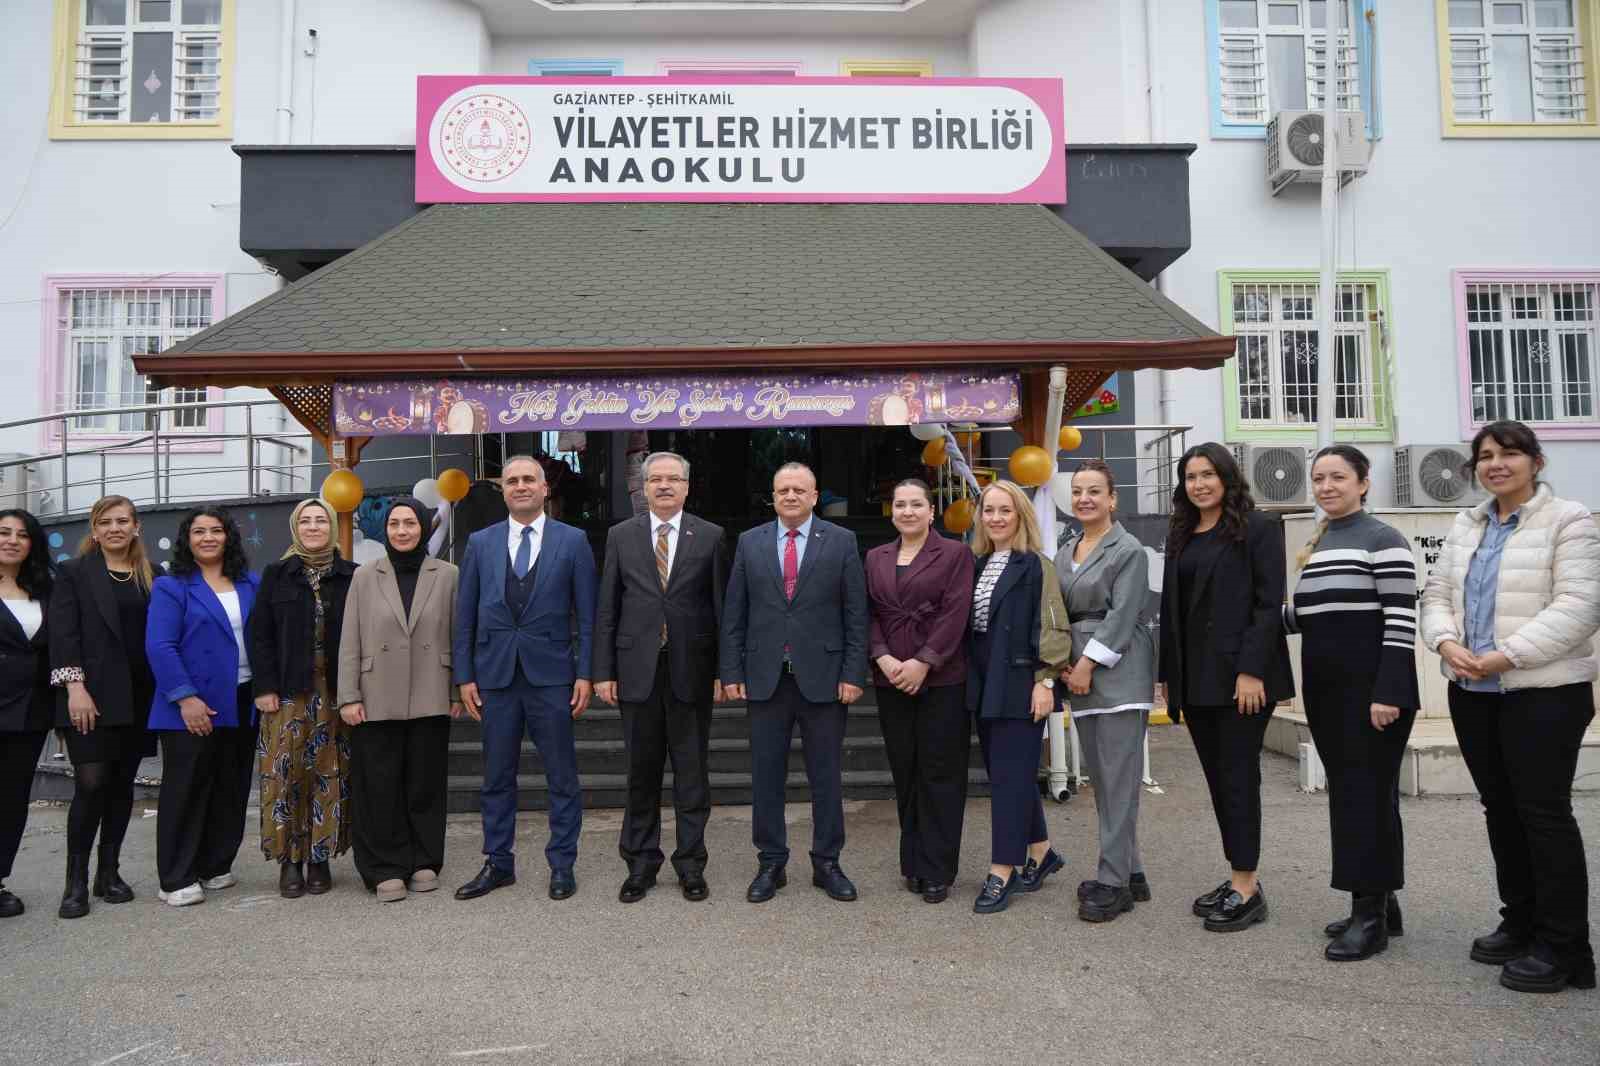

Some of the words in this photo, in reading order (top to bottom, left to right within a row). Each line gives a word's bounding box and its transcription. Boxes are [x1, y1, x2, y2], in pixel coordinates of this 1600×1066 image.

[553, 91, 635, 105] GAZİANTEP
[647, 91, 735, 108] ŞEHİTKAMİL
[553, 107, 760, 149] VİLAYETLER
[773, 107, 901, 150] HİZMET
[912, 108, 1033, 151] BİRLİĞİ
[548, 157, 805, 183] ANAOKULU
